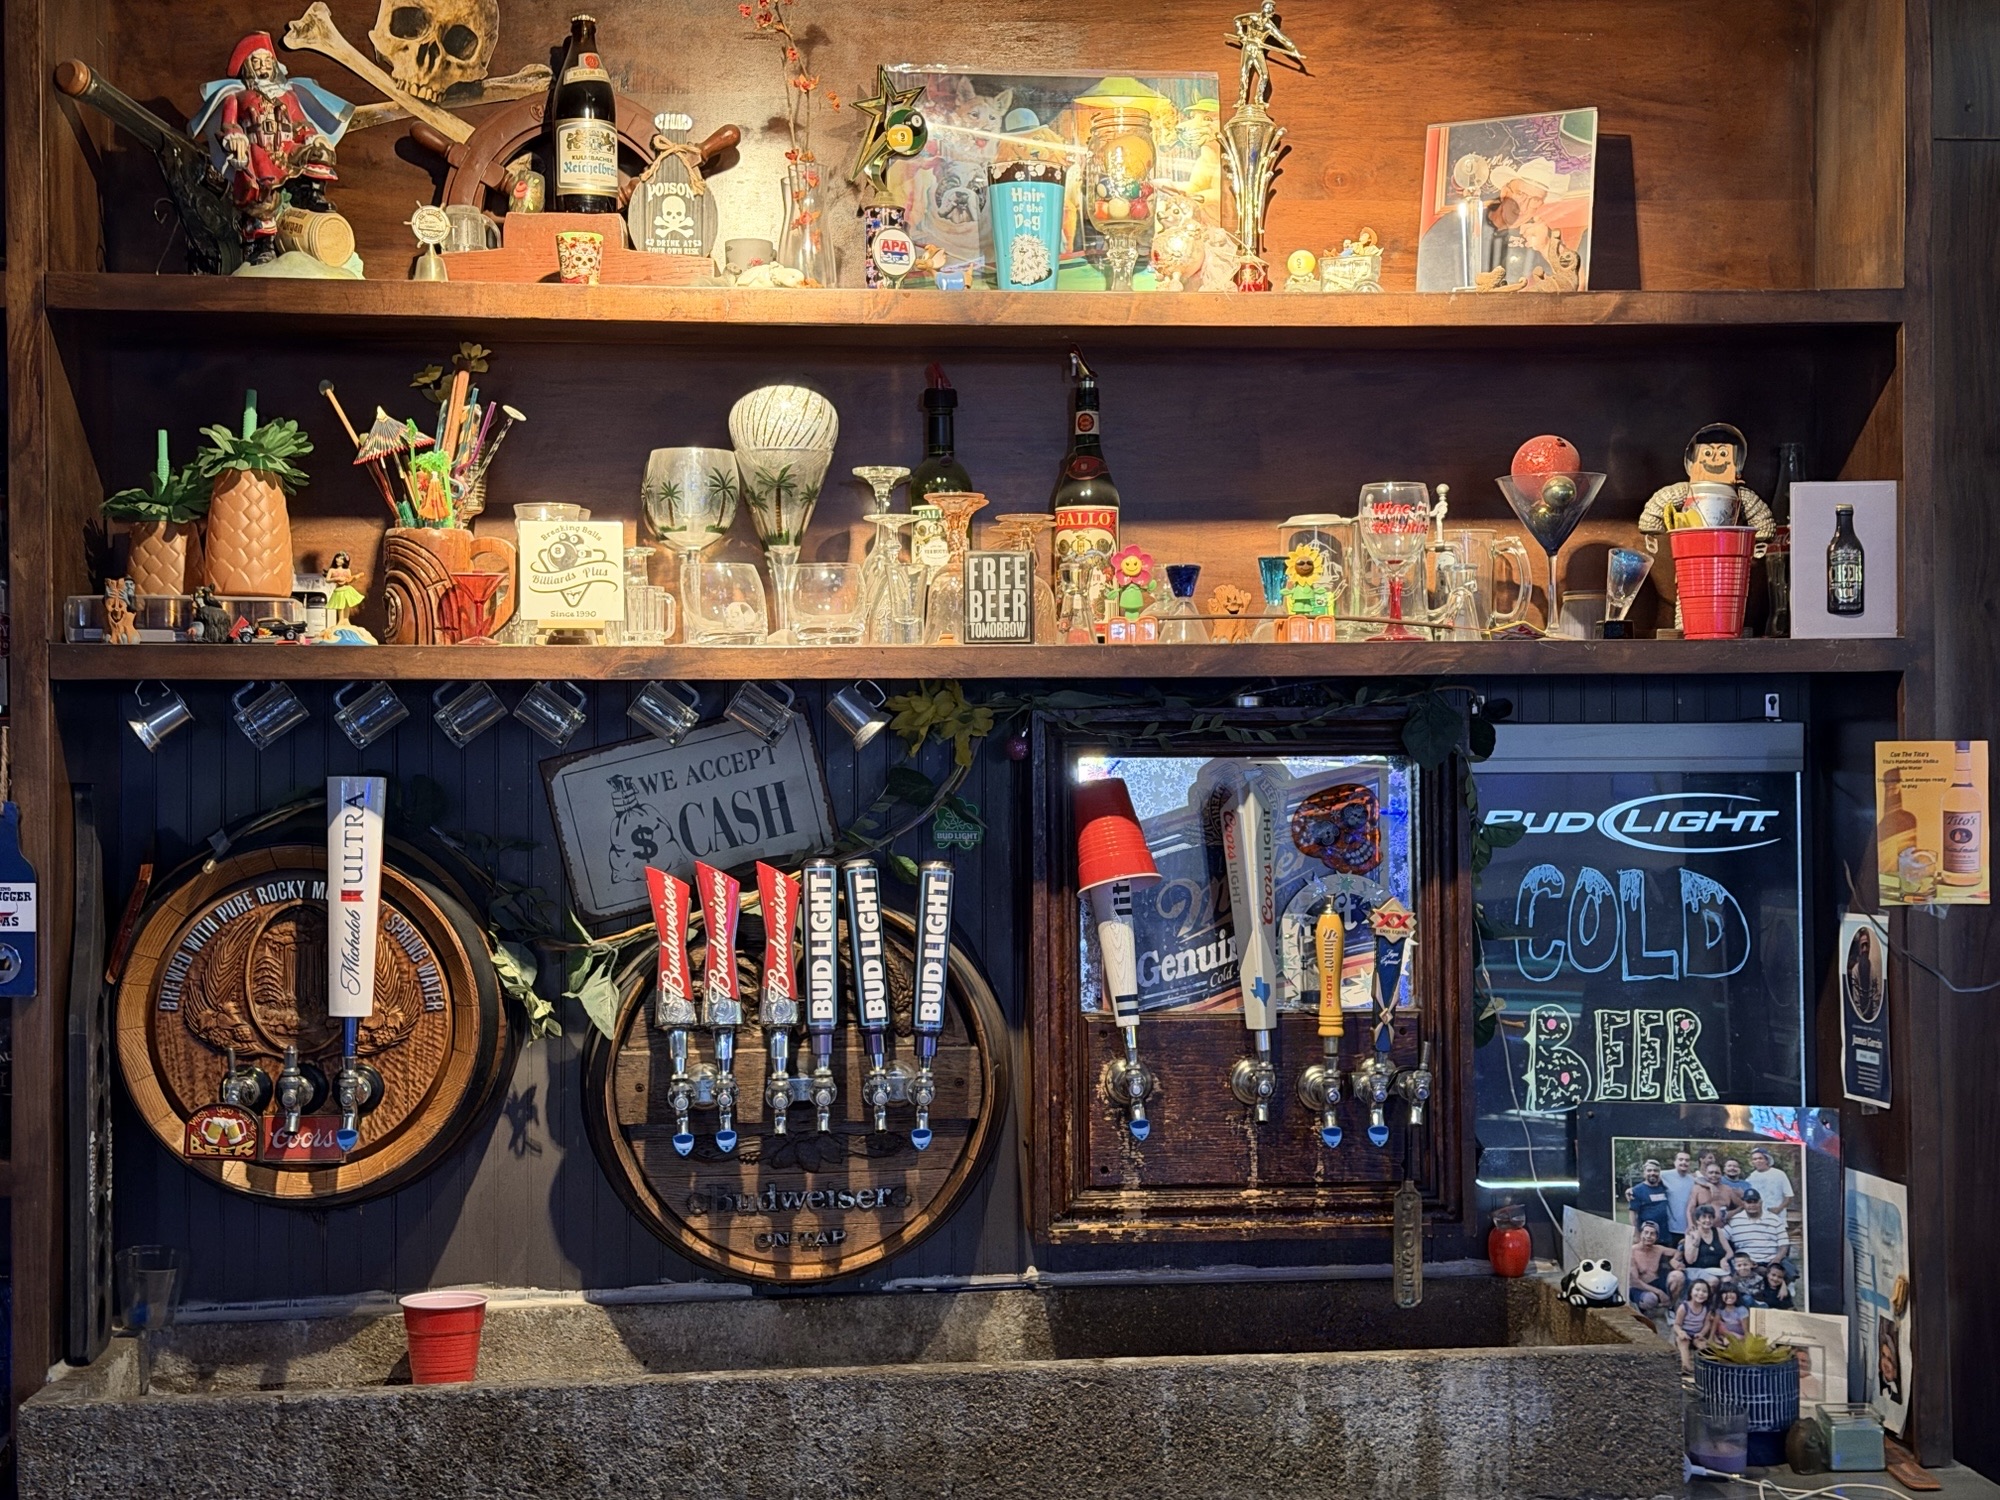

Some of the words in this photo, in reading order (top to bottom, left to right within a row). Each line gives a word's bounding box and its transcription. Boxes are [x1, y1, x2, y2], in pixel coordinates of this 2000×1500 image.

[647, 182, 695, 202] POISON
[1011, 187, 1045, 202] Hair
[1013, 204, 1024, 213] of
[1027, 204, 1044, 213] the
[667, 247, 682, 255] OWN
[881, 240, 908, 253] APA
[540, 525, 581, 541] Breaking
[582, 526, 602, 541] Balls
[1057, 512, 1111, 526] GALLO
[532, 572, 576, 585] Billiards
[583, 567, 608, 578] Plus
[969, 557, 1026, 590] FREE
[969, 590, 1026, 622] BEER
[970, 622, 1026, 639] TOMORROW
[637, 769, 678, 796] WE
[685, 745, 777, 786] ACCEPT
[343, 791, 365, 885] ULTRA
[678, 780, 798, 859] CASH
[936, 832, 954, 840] BUD
[955, 831, 979, 840] LIGHT
[1222, 810, 1237, 860] Coors
[1263, 809, 1272, 862] LIGHT
[1946, 815, 1977, 826] Tito's
[0, 891, 32, 902] IGGER
[1112, 877, 1133, 916] lit
[1229, 862, 1242, 906] LIGHT
[1261, 863, 1274, 927] Coors
[810, 874, 833, 956] LIGHT
[855, 874, 882, 957] LIGHT
[924, 876, 950, 959] LIGHT
[1514, 864, 1750, 983] COLD
[159, 949, 194, 1012] BREWED
[182, 917, 218, 954] WITH
[214, 891, 255, 924] PURE
[255, 880, 307, 906] ROCKY
[340, 907, 361, 997] Michelob
[660, 874, 685, 1004] Budweiser
[709, 871, 732, 1004] Budweiser
[767, 871, 791, 1004] Budweiser
[1323, 926, 1339, 972] Shiner
[382, 912, 430, 964] SPRING
[416, 959, 448, 1012] WATER
[811, 959, 834, 1019] BUD
[862, 959, 888, 1020] BUD
[920, 962, 944, 1022] BUD
[1325, 975, 1333, 1008] BOCK
[1522, 1003, 1720, 1113] BEER
[215, 1106, 234, 1117] you
[189, 1134, 255, 1157] BEER
[271, 1126, 336, 1149] Coors
[706, 1182, 893, 1215] Budweiser
[754, 1231, 791, 1249] ON
[799, 1229, 847, 1249] TAP
